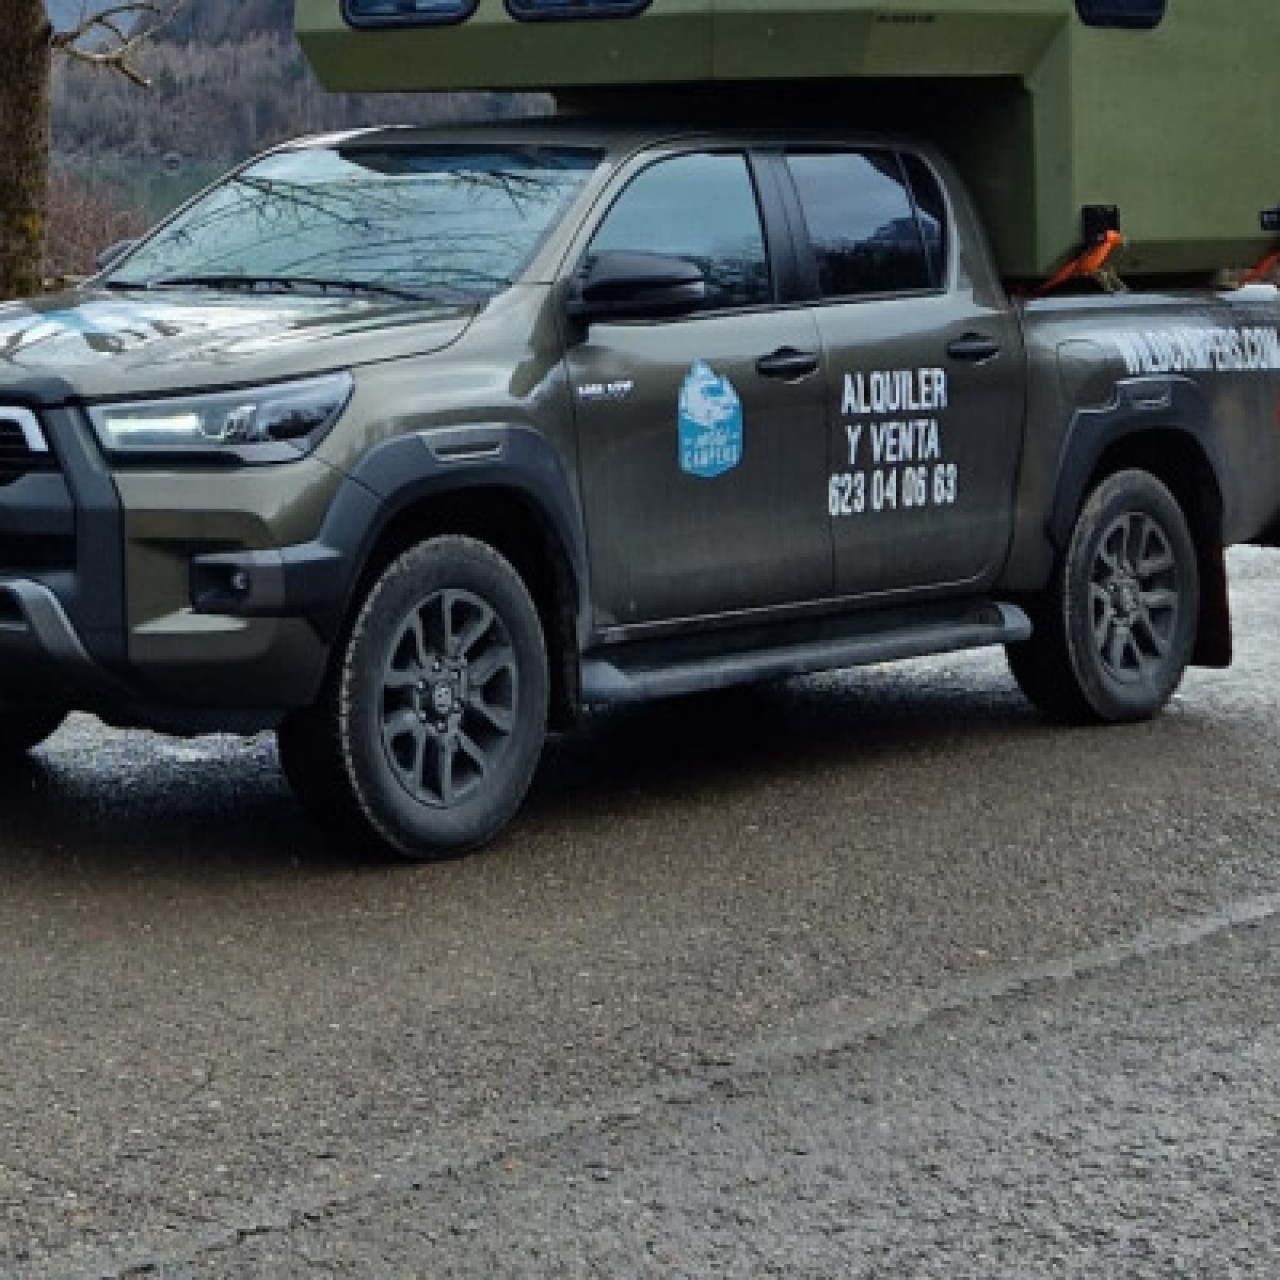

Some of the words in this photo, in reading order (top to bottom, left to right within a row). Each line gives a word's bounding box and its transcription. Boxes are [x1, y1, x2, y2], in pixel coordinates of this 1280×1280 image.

[841, 368, 947, 415] ALQUILER
[845, 424, 862, 465] Y
[870, 419, 940, 463] VENTA
[828, 471, 865, 516] 623
[872, 468, 897, 511] 04
